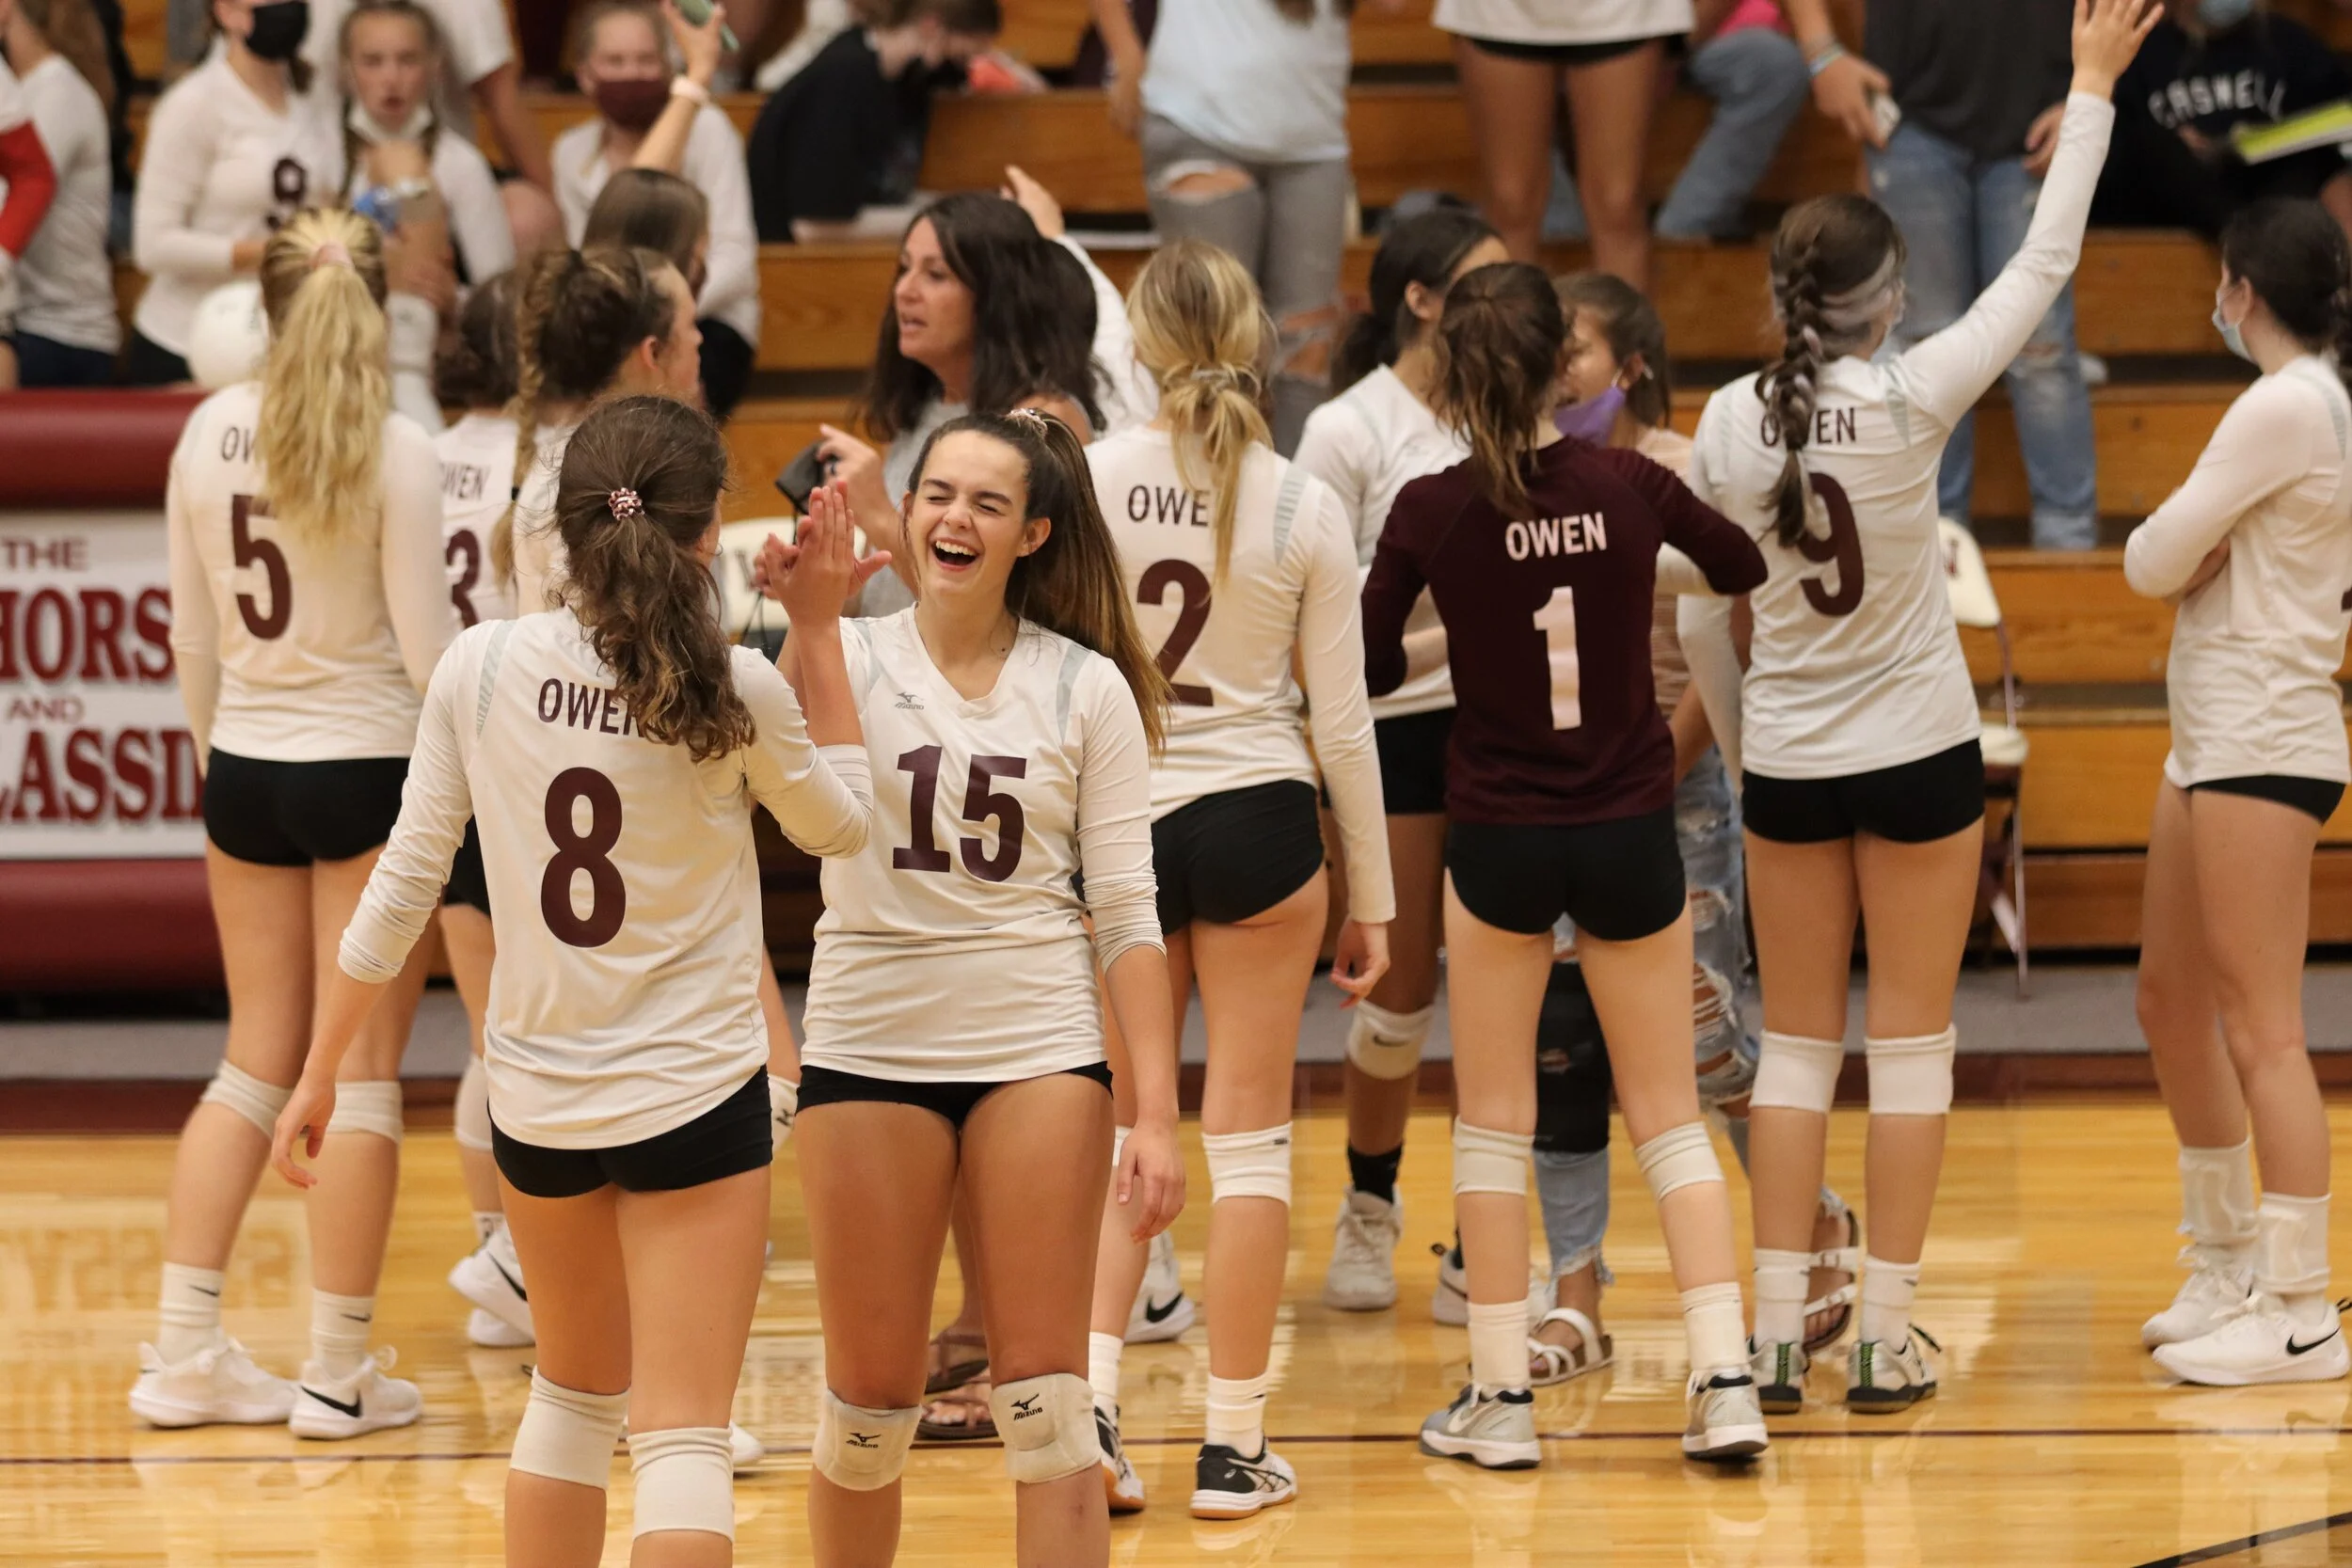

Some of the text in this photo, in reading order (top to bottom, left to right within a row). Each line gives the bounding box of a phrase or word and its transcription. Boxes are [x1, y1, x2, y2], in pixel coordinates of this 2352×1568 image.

[1760, 406, 1856, 448] OEN
[1, 535, 87, 571] THE
[1127, 484, 1211, 527] OWE
[1504, 511, 1608, 562] OWEN
[1796, 471, 1866, 618] 9
[231, 494, 292, 641] 5
[446, 529, 481, 629] 3
[1136, 558, 1215, 707] 2
[1533, 585, 1582, 731] 1
[8, 695, 86, 723] AND
[540, 766, 627, 948] 8
[893, 744, 1027, 882] 15
